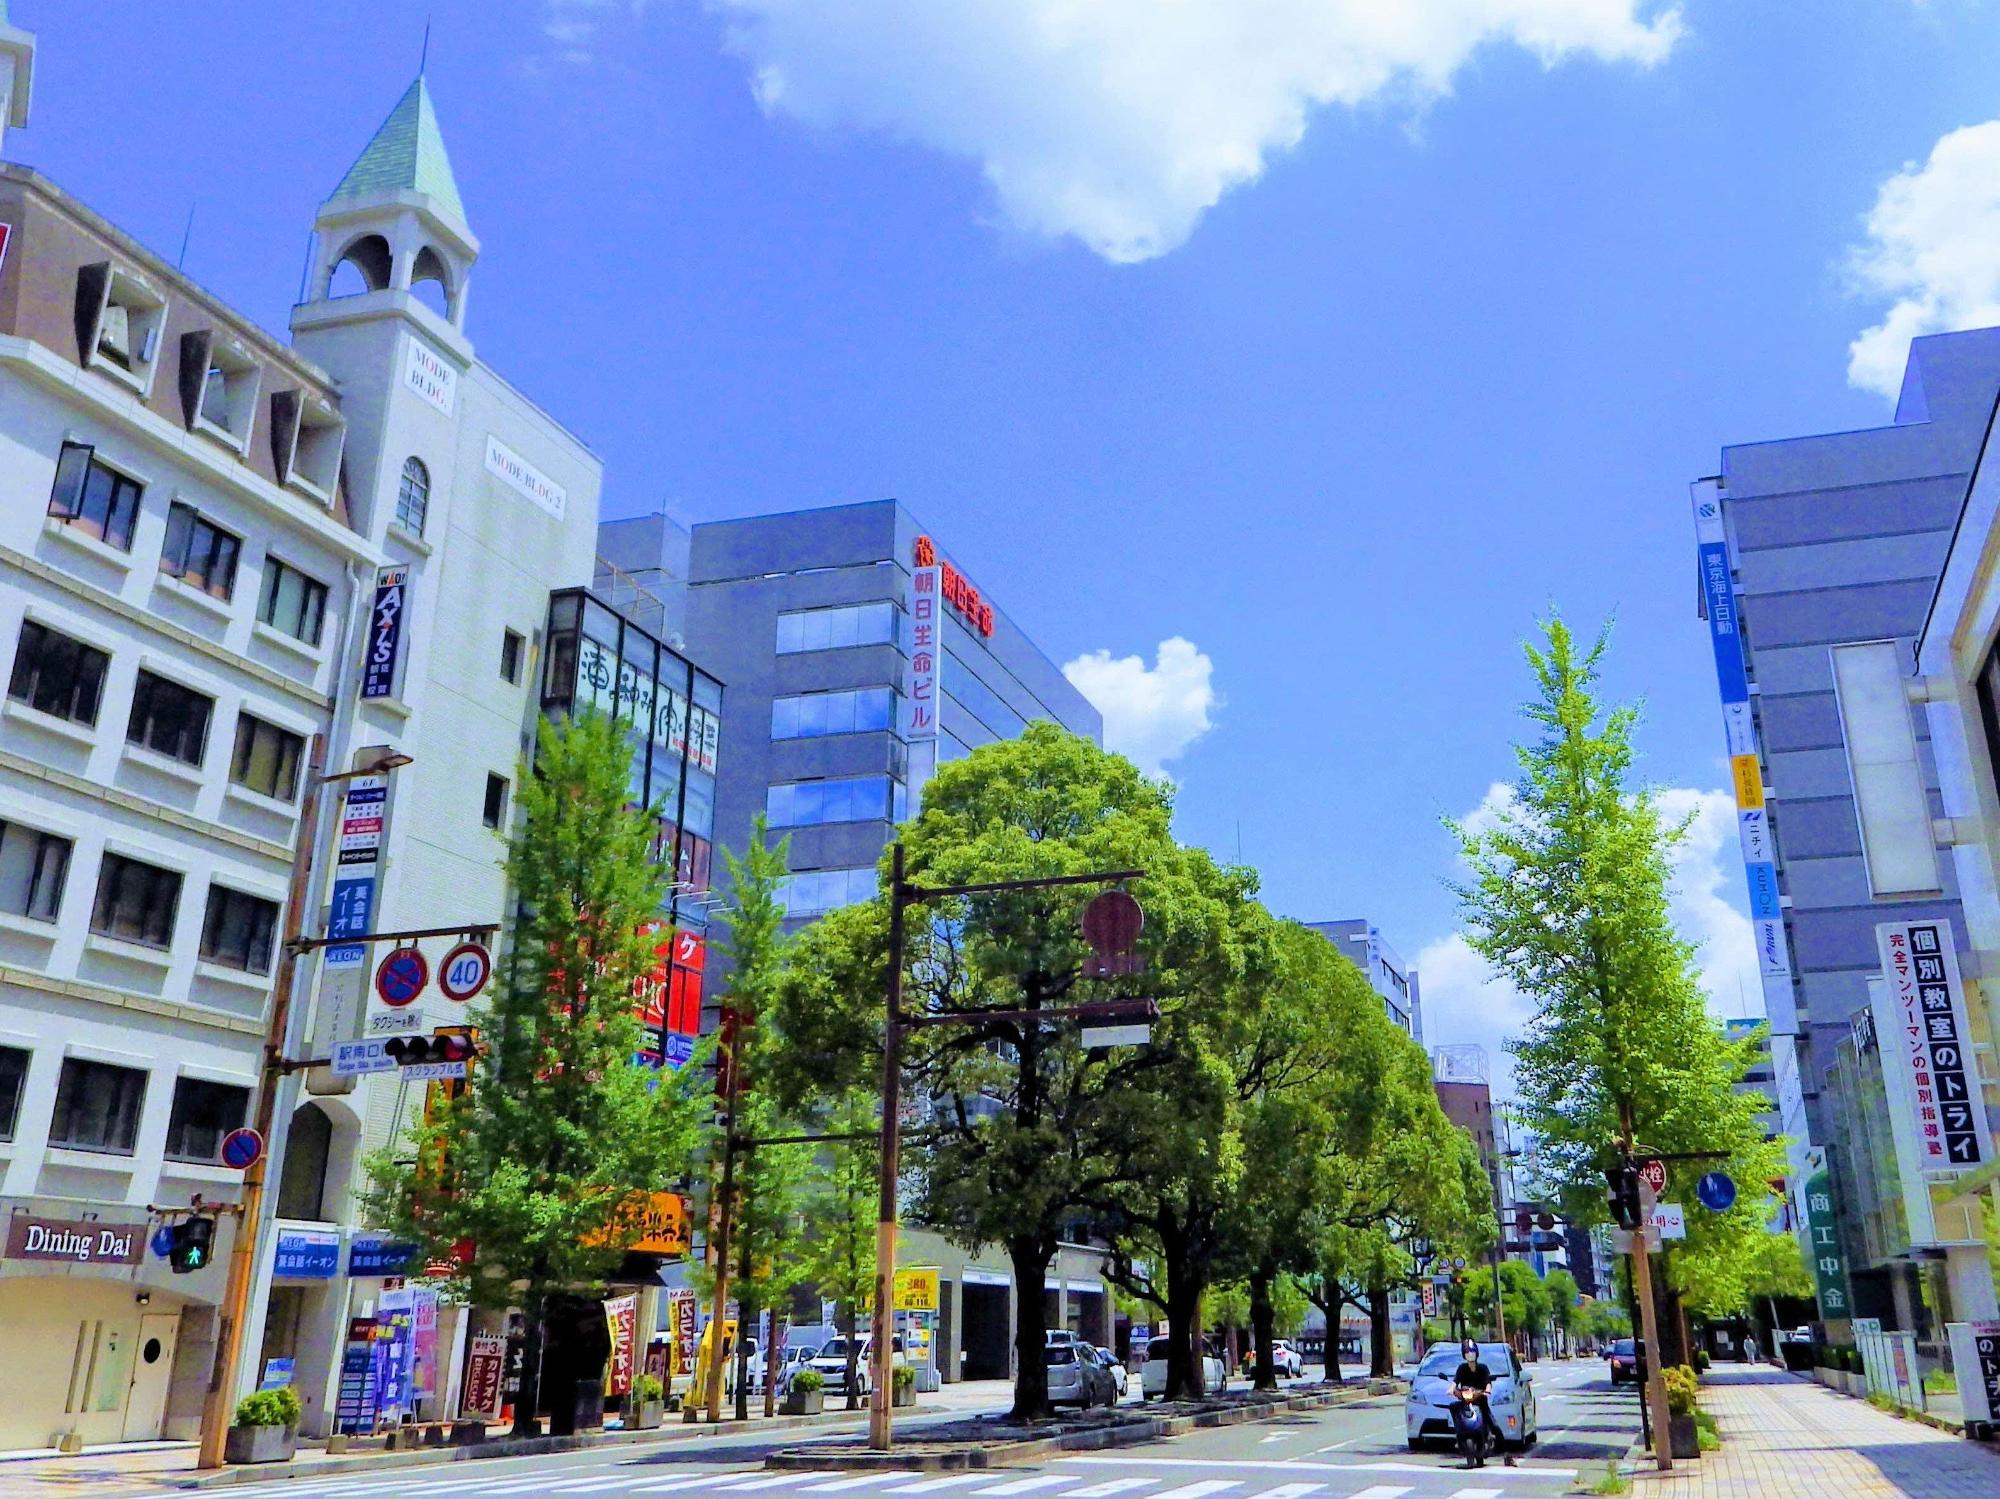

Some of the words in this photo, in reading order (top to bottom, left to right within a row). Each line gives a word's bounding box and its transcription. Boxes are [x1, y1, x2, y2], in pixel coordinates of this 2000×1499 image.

[416, 347, 450, 386] MODE
[412, 370, 448, 408] BLDG.
[491, 448, 522, 481] MODE
[942, 563, 993, 636] 朝日生命
[1707, 554, 1733, 635] 東京海上日動
[911, 572, 934, 729] 朝日生命ビル
[1750, 825, 1761, 858] ニチイ
[351, 887, 368, 929] 英会話
[1757, 867, 1772, 915] KUMON
[328, 949, 362, 963] AEON
[1765, 923, 1778, 965] FORVAL
[450, 960, 478, 985] 40
[1889, 933, 1943, 1156] 完全マンツーマンの個別指導塾
[1912, 931, 1977, 1161] 個別教室のトライ
[25, 1225, 93, 1260] Dining
[97, 1230, 132, 1258] Dai
[278, 1254, 336, 1268] 英会話イーオン
[1809, 1192, 1845, 1309] 商工中金
[480, 1358, 499, 1411] カラオケ
